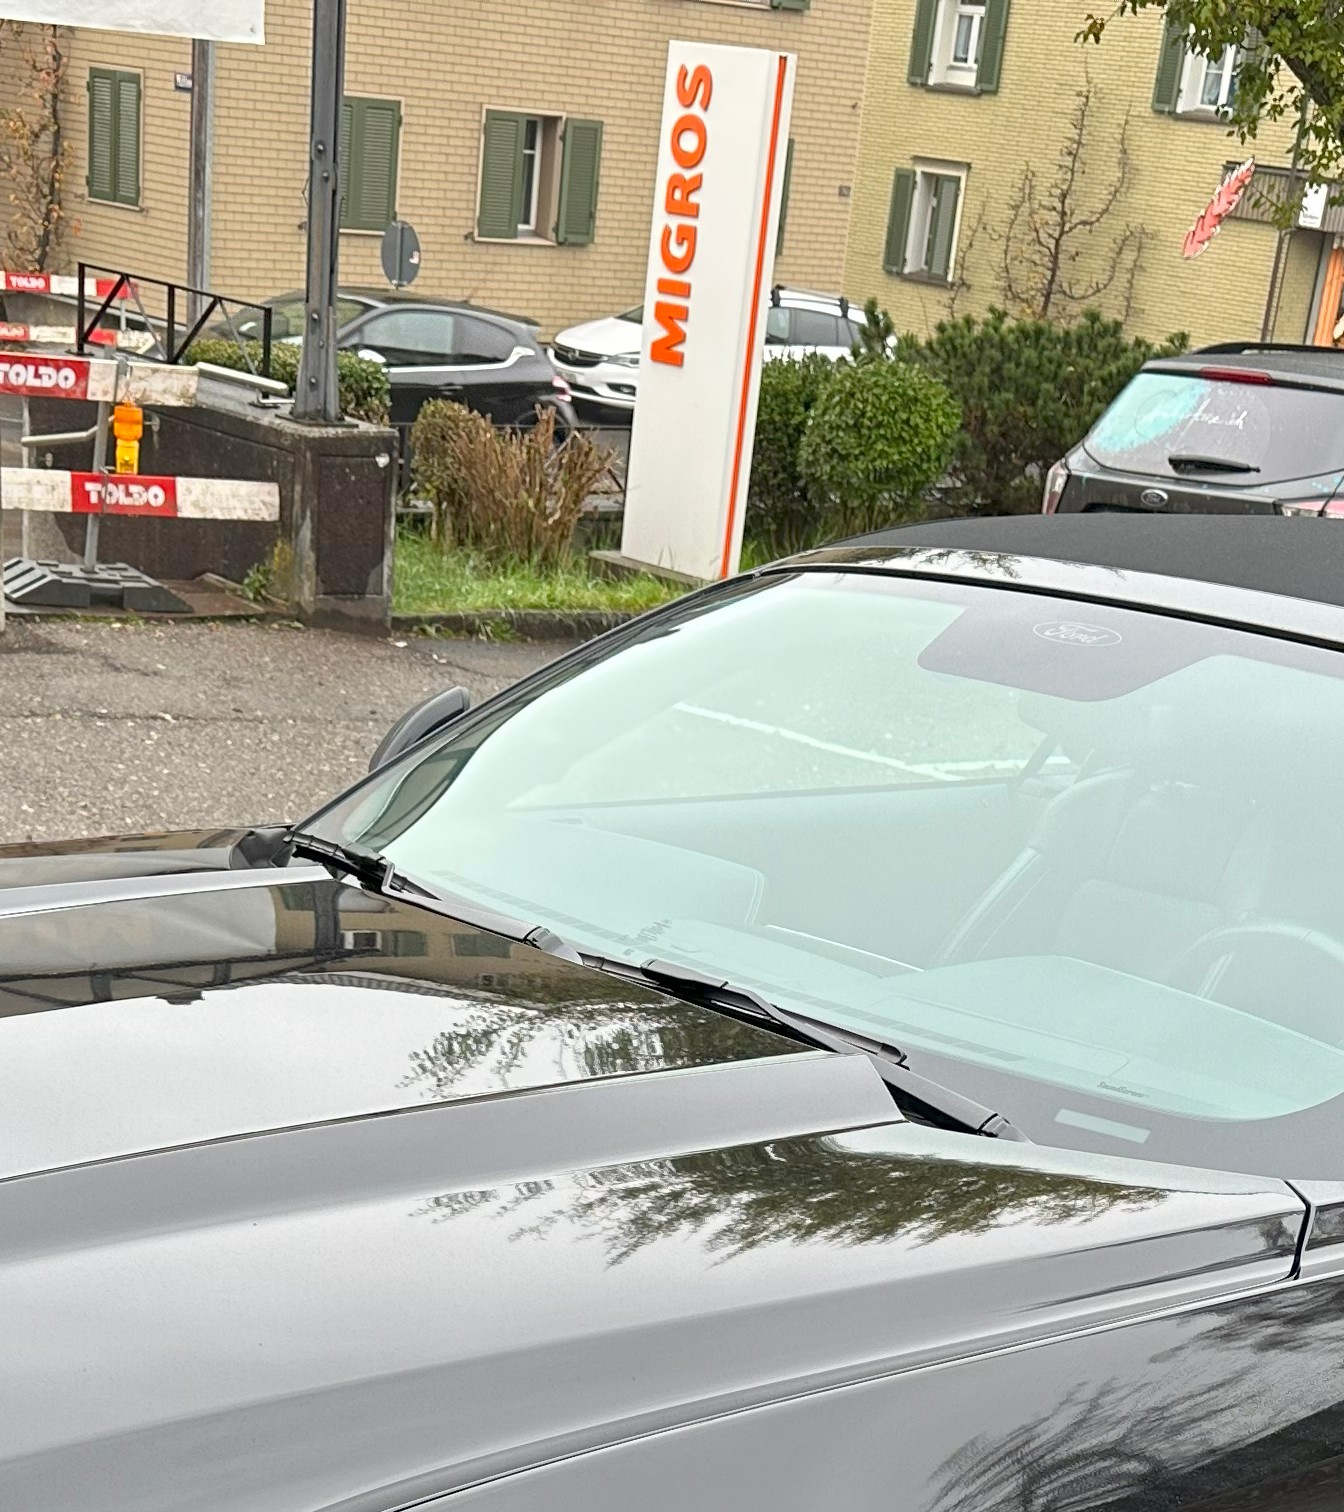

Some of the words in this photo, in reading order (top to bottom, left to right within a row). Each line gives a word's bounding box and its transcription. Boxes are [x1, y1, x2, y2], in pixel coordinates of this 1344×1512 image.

[650, 63, 713, 368] MIGROS
[9, 276, 46, 290] TOLDO
[84, 482, 166, 508] TOLDO
[1044, 624, 1109, 643] Ford
